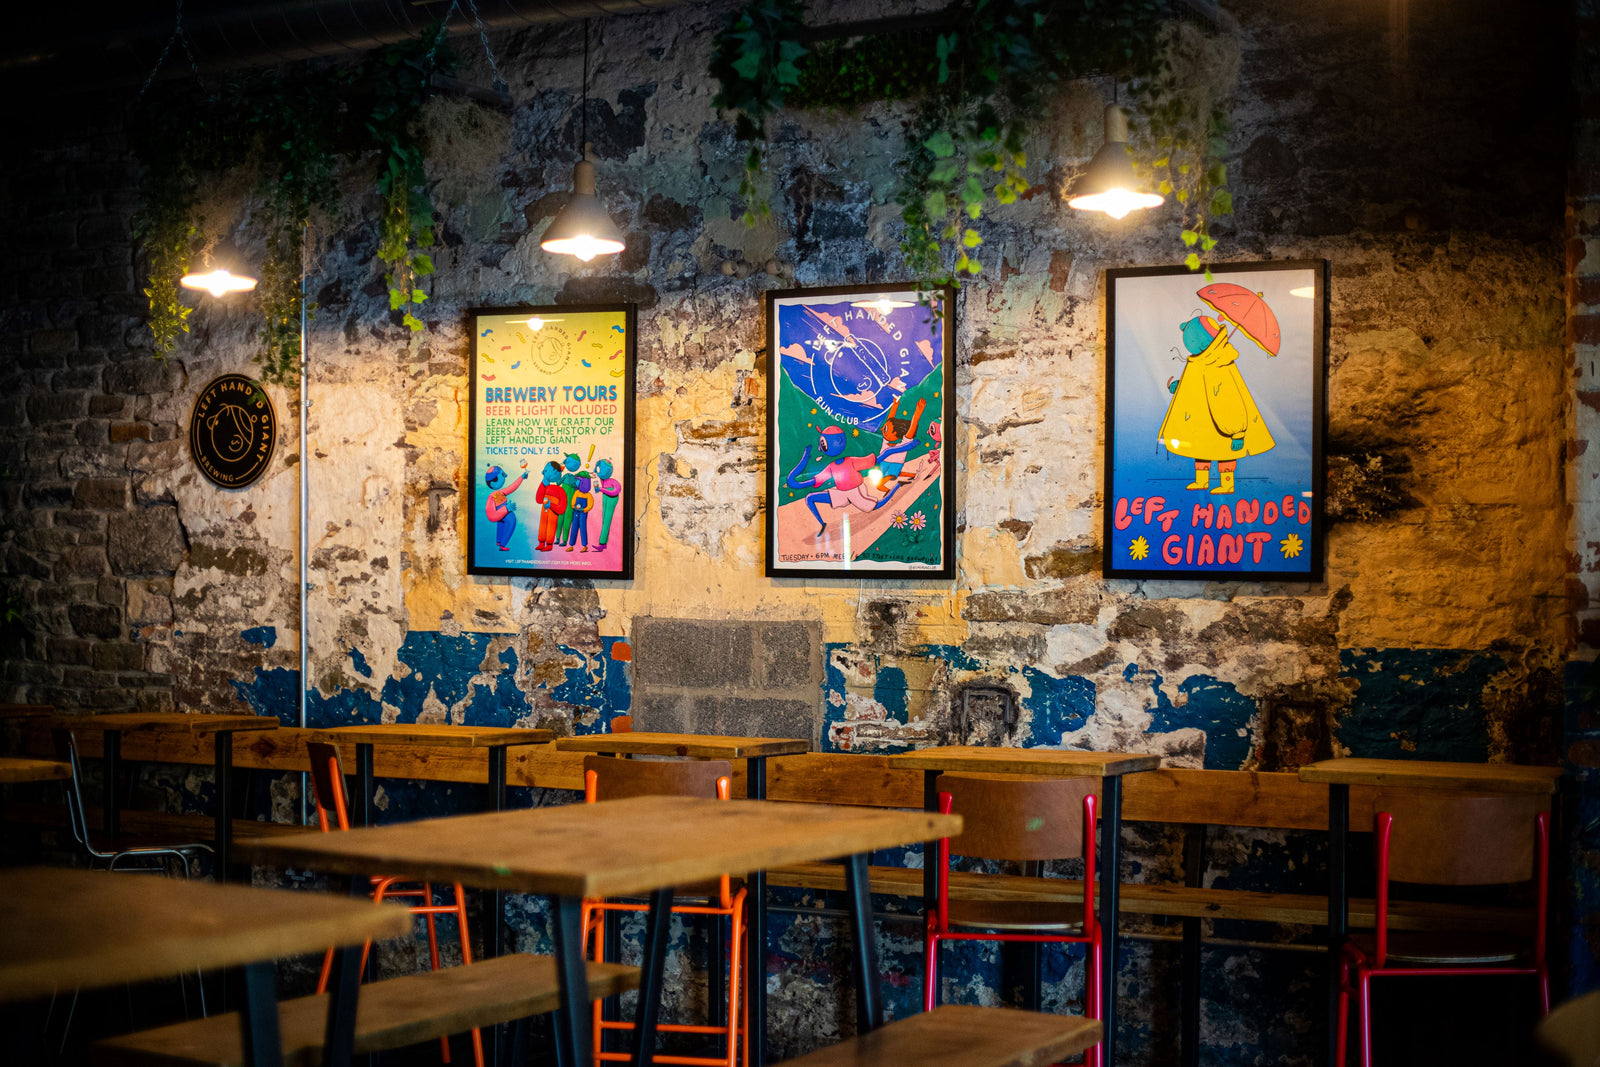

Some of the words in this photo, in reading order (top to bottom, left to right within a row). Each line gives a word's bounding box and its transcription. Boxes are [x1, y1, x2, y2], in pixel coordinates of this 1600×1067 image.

[812, 318, 839, 351] LEFT
[844, 310, 902, 341] HANDED
[892, 348, 910, 403] GIANT
[485, 387, 557, 403] BREWERY
[562, 385, 618, 402] TOURS
[486, 405, 511, 416] BEER
[515, 405, 555, 416] FLIGHT
[559, 404, 618, 415] INCLUDED
[815, 396, 832, 416] RUN
[834, 412, 859, 425] CLUB
[198, 388, 217, 418] LEFT
[220, 381, 264, 409] HANDD
[256, 414, 270, 463] GIANT
[486, 418, 515, 427] LEARN
[517, 418, 541, 426] HOW
[544, 418, 558, 426] WE
[561, 417, 591, 426] CRAFT
[594, 417, 615, 426] OUR
[486, 427, 512, 436] BEERS
[514, 427, 534, 435] AND
[537, 427, 554, 435] THE
[556, 426, 597, 435] HISTORY
[600, 426, 613, 435] OF
[486, 436, 506, 444] LEFT
[509, 436, 547, 444] HANDED
[549, 435, 581, 444] GIANT.
[485, 446, 519, 455] TICKETS
[520, 446, 544, 455] ONLY
[547, 446, 560, 455] £15
[201, 455, 234, 482] BREWING
[1114, 496, 1180, 532] LEFT
[1191, 495, 1311, 530] HANDED
[781, 553, 809, 561] TUESDAY
[1162, 532, 1272, 566] GIANT
